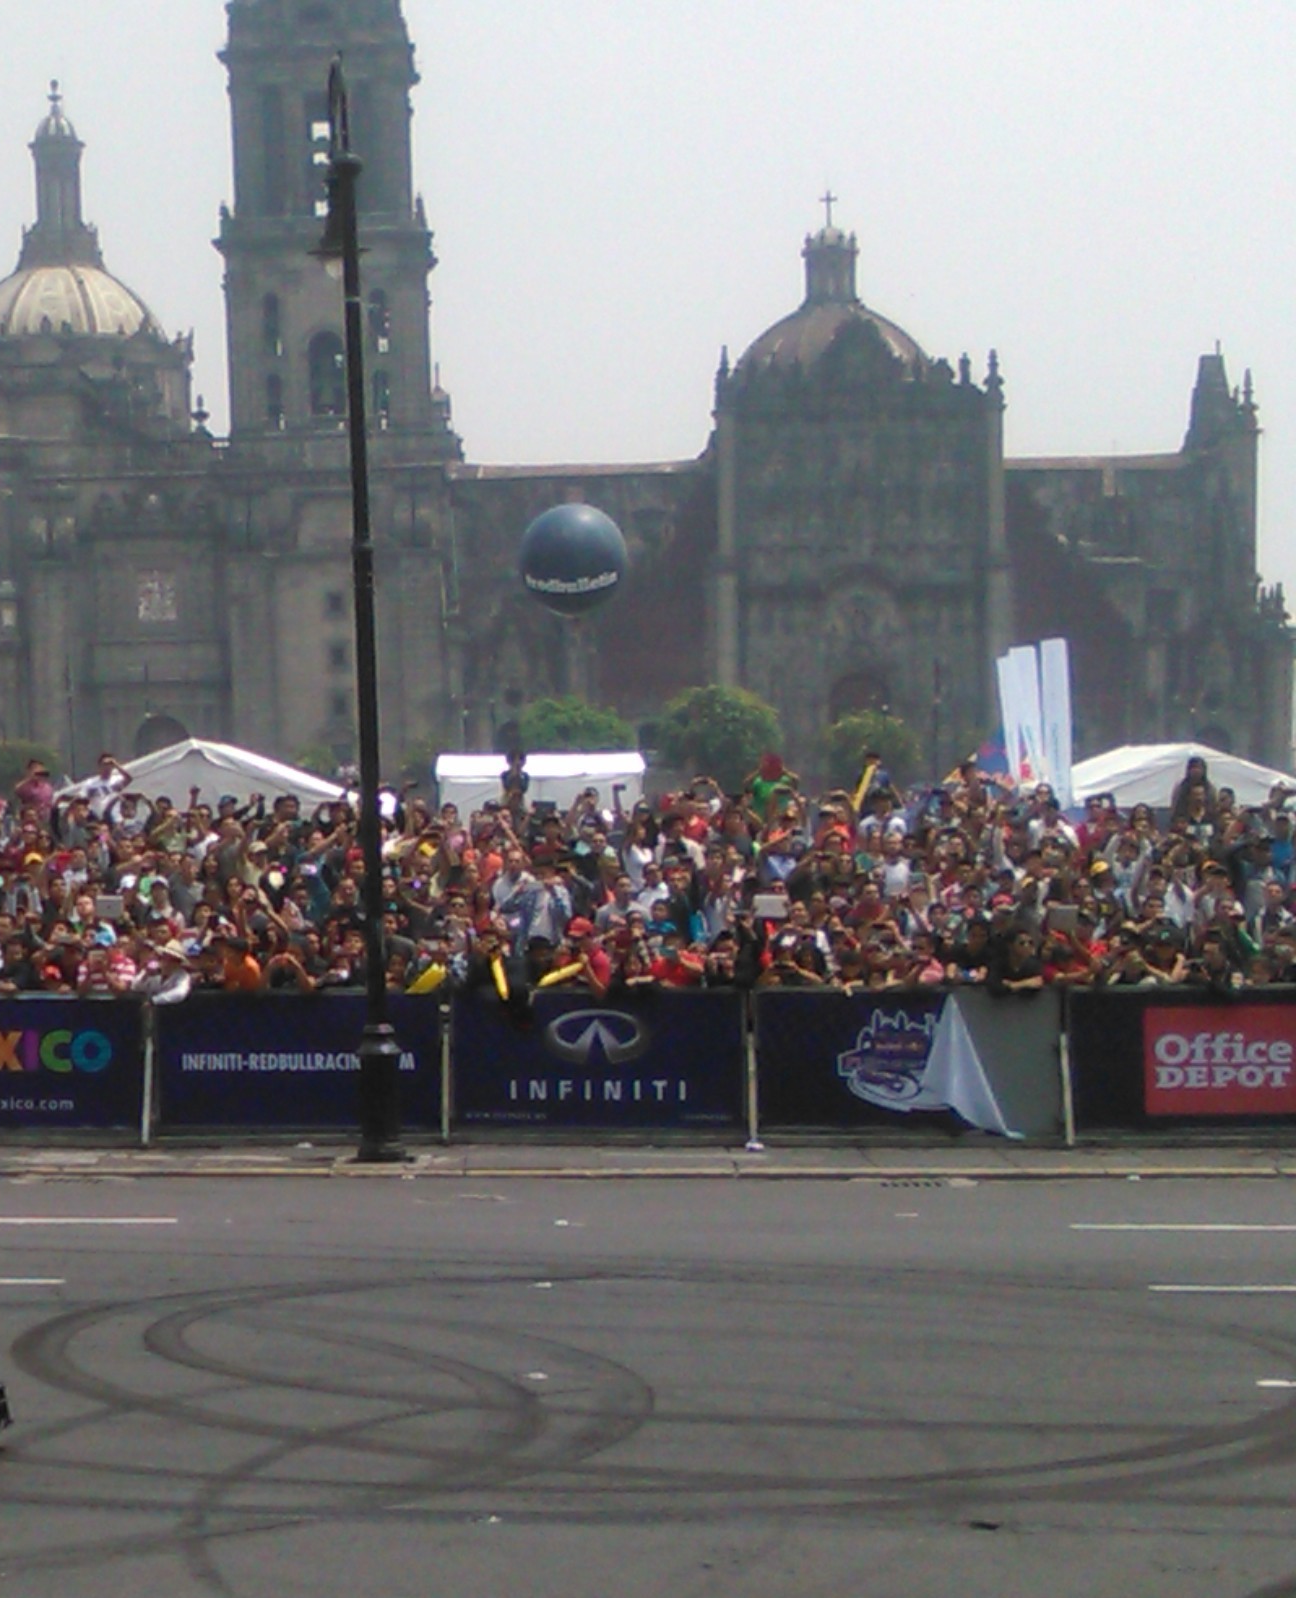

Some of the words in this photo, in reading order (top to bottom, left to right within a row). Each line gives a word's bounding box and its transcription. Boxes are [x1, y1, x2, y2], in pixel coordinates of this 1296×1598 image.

[1154, 1033, 1293, 1064] Office
[1155, 1066, 1292, 1088] DEPOT
[509, 1079, 687, 1101] INFINITI
